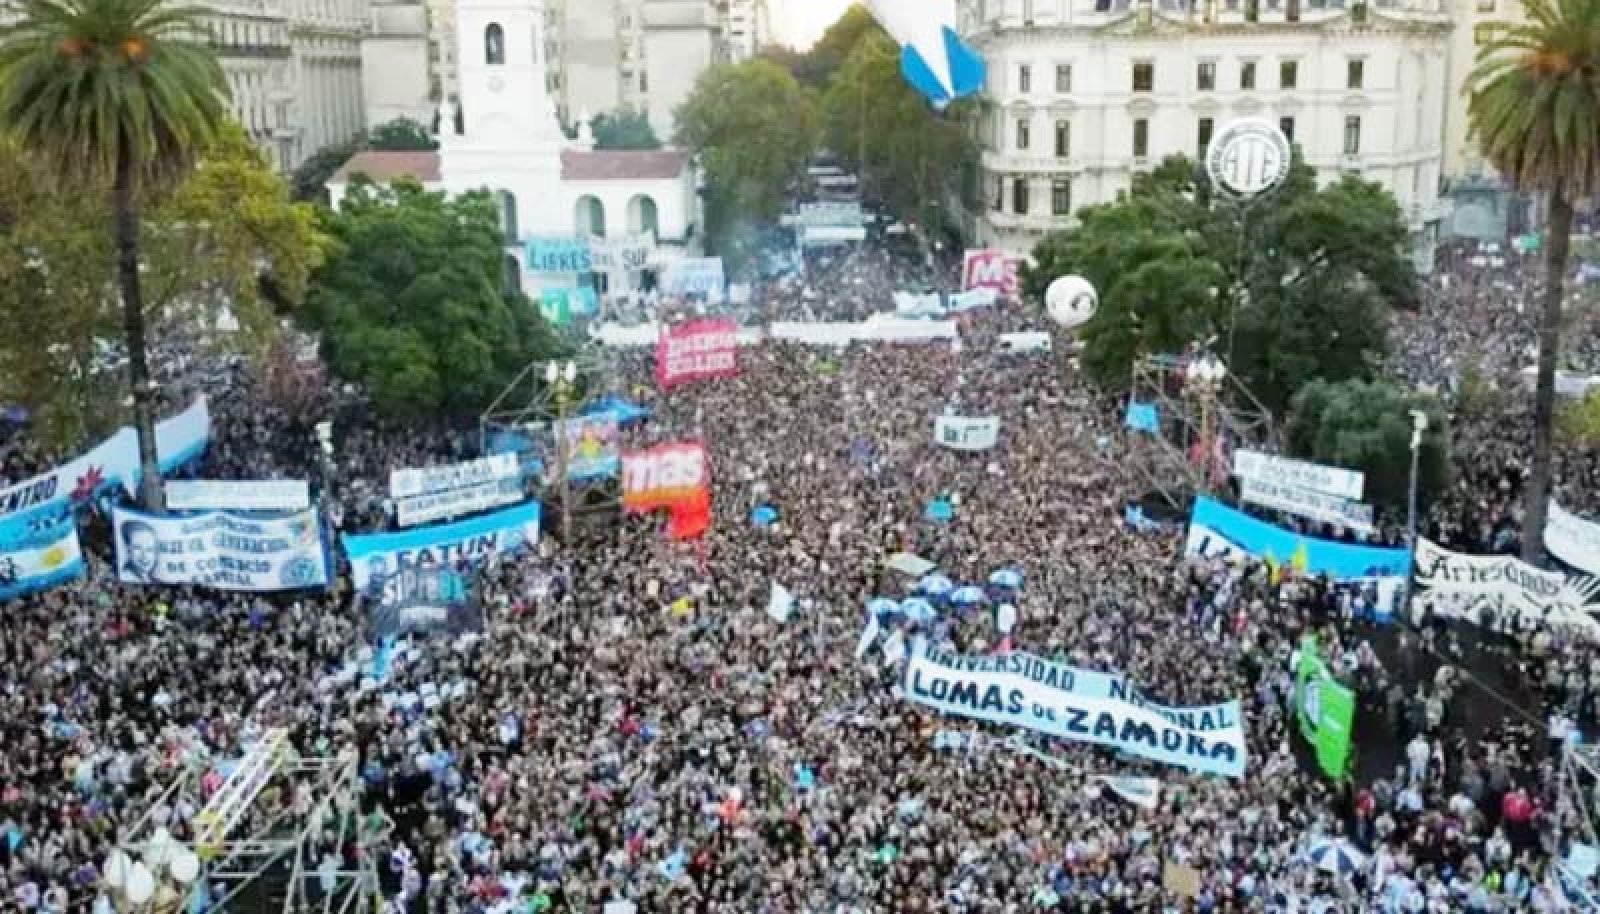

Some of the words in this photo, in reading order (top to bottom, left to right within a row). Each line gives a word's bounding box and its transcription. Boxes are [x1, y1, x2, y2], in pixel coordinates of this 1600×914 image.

[1223, 138, 1276, 186] ATE
[622, 451, 703, 493] mas
[397, 532, 503, 566] FATUN
[925, 645, 1074, 691] UNIVERSIDAD
[913, 668, 1025, 714] LOMAS
[1065, 706, 1237, 763] ZAMORA
